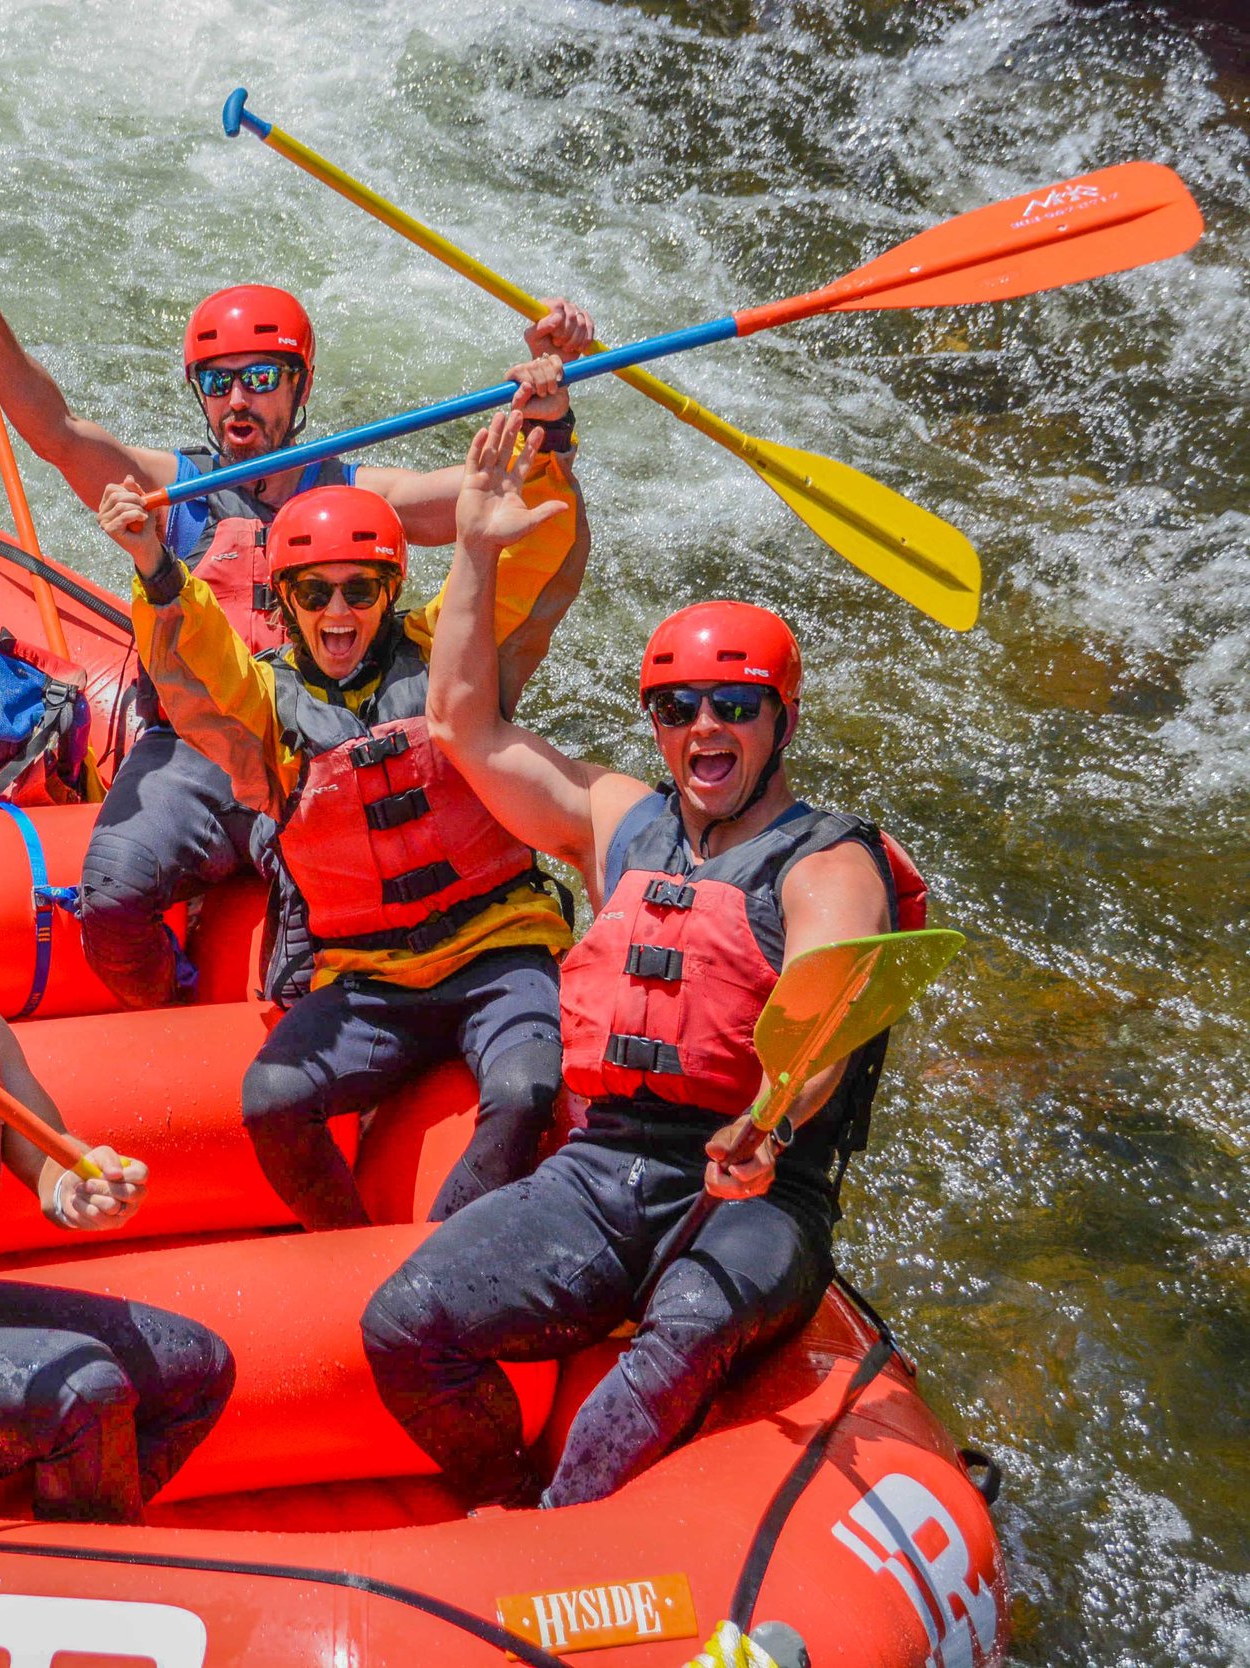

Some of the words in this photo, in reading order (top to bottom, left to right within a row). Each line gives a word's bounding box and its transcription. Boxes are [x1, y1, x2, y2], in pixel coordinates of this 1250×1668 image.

[278, 337, 297, 346] NRS
[375, 546, 395, 555] NRS
[211, 551, 239, 561] NRS
[744, 667, 769, 677] NRS
[601, 911, 625, 920] NRS
[531, 1581, 662, 1648] HYSIDE
